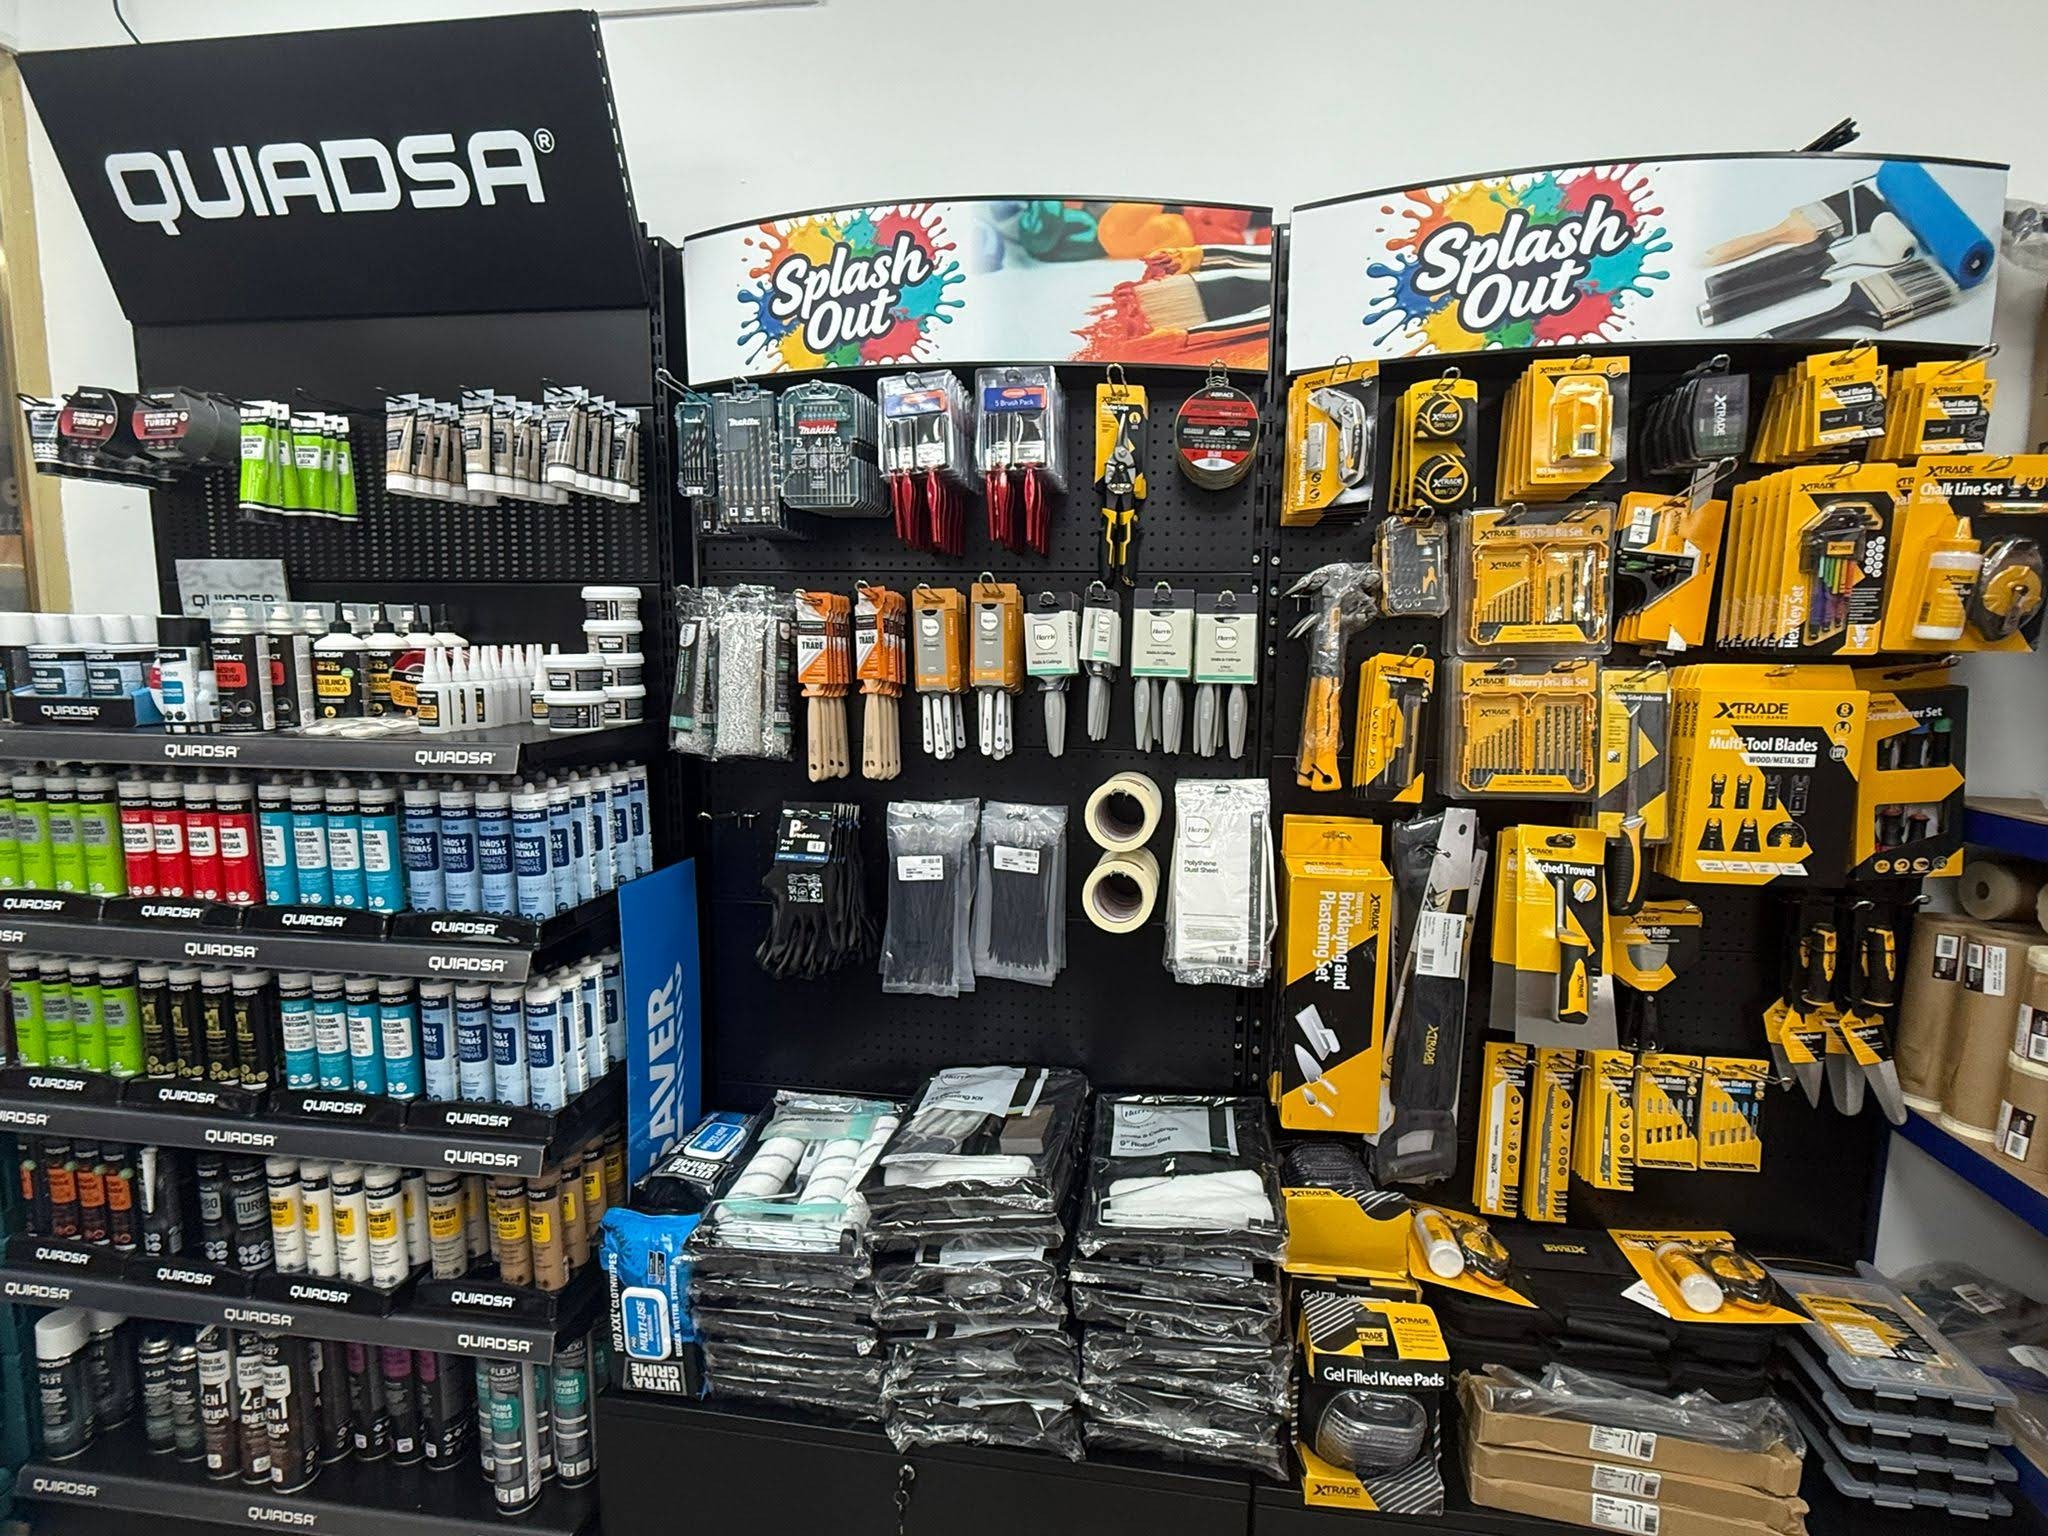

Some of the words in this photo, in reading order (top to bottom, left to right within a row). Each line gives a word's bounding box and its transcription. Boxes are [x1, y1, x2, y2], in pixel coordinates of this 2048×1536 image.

[1414, 196, 1630, 294] Splash
[773, 231, 931, 316] Splash
[1459, 266, 1582, 331] Out
[805, 288, 896, 351] Out
[1539, 366, 1566, 374] XTRADE
[1304, 378, 1326, 389] XTRADE
[1822, 374, 1856, 387] XTRADE
[1852, 386, 1873, 397] Blades
[1930, 385, 1964, 396] XTRADE
[1959, 398, 1979, 407] Blades
[1431, 412, 1458, 421] XTRADE
[1714, 393, 1728, 436] XTRADE
[72, 417, 99, 428] TURBO
[144, 418, 170, 428] TURBO
[727, 417, 760, 427] Makita
[798, 425, 838, 435] Makita
[796, 438, 803, 448] 5
[815, 437, 822, 446] 4
[835, 437, 842, 447] 3
[1925, 465, 1975, 478] XTRADE
[1432, 477, 1463, 487] XTRADE
[1800, 482, 1836, 492] XTRADE
[1920, 482, 1954, 496] Chalk
[1955, 482, 1980, 495] Line
[1981, 483, 2004, 496] Set
[1480, 529, 1517, 540] XTRADE
[1519, 528, 1536, 538] HSS
[1569, 527, 1583, 537] Set
[1489, 560, 1522, 570] XTRADE
[1793, 586, 1805, 603] Set
[1788, 604, 1803, 627] Key
[859, 635, 875, 645] TRADE
[1035, 633, 1056, 641] Harris
[1784, 627, 1799, 649] Hex
[801, 641, 824, 650] TRADE
[1470, 677, 1505, 687] XTRADE
[1508, 677, 1543, 688] Masonry
[1573, 678, 1589, 687] Set
[1609, 683, 1636, 691] XTRADE
[41, 704, 99, 717] QUIADSA
[1479, 708, 1511, 717] XTRADE
[1713, 702, 1789, 718] XTRADE
[1840, 703, 1850, 715] 8
[1926, 707, 1943, 717] Set
[165, 743, 239, 758] QUIADSA
[1708, 736, 1773, 752] Multi-Tool
[1774, 738, 1818, 752] Blades
[415, 749, 496, 765] QUIADSA
[1749, 756, 1796, 764] WOOD/METAL
[1797, 756, 1811, 764] SET
[788, 819, 821, 839] Predator
[1186, 826, 1210, 834] Harris
[1184, 859, 1217, 868] Polythene
[1565, 864, 1596, 877] Trowel
[3, 898, 63, 910] QUIADSA
[141, 905, 201, 919] QUIADSA
[1370, 892, 1381, 931] XTRADE
[282, 913, 345, 927] QUIADSA
[1312, 890, 1336, 958] Plastering
[1630, 915, 1662, 924] XTRADE
[431, 921, 498, 935] QUIADSA
[1332, 891, 1355, 963] Bricklaying
[1652, 927, 1671, 936] Knife
[185, 942, 257, 959] QUIADSA
[429, 955, 507, 972] QUIADSA
[1315, 960, 1332, 982] Set
[1333, 964, 1350, 990] and
[1427, 1024, 1440, 1065] XTRADE
[28, 1076, 86, 1091] QUIADSA
[1665, 1077, 1687, 1085] Blades
[1731, 1080, 1752, 1088] Blades
[159, 1088, 217, 1104] QUIADSA
[303, 1099, 365, 1115] QUIADSA
[0, 1110, 48, 1126] IADSA
[446, 1112, 511, 1128] QUIADSA
[205, 1129, 277, 1147] QUIADSA
[1131, 1140, 1156, 1148] Roller
[1157, 1136, 1171, 1144] Set
[444, 1149, 521, 1167] QUIADSA
[674, 1158, 720, 1172] GRIME
[667, 1163, 713, 1179] ULTRA
[36, 1247, 90, 1265] QUIADSA
[157, 1267, 215, 1286] QUIADSA
[4, 1282, 72, 1301] QUIADSA
[290, 1285, 351, 1304] QUIADSA
[451, 1291, 515, 1309] QUIADSA
[224, 1308, 294, 1327] QUIADSA
[1394, 1316, 1429, 1325] XTRADE
[636, 1300, 649, 1351] MULTI-USE
[457, 1334, 533, 1354] QUIADSA
[613, 1335, 624, 1352] 100
[631, 1362, 680, 1377] GRIME
[631, 1376, 681, 1392] ULTRA
[1323, 1366, 1345, 1382] Gel
[1348, 1368, 1379, 1385] Filled
[1380, 1371, 1413, 1387] Knee
[1414, 1373, 1445, 1388] Pads
[216, 1381, 227, 1404] 1
[240, 1389, 252, 1410] 2
[277, 1397, 288, 1419] 1
[33, 1478, 99, 1497] QUIADSA
[1312, 1484, 1361, 1496] XTRADE
[248, 1506, 317, 1526] QUIADSA
